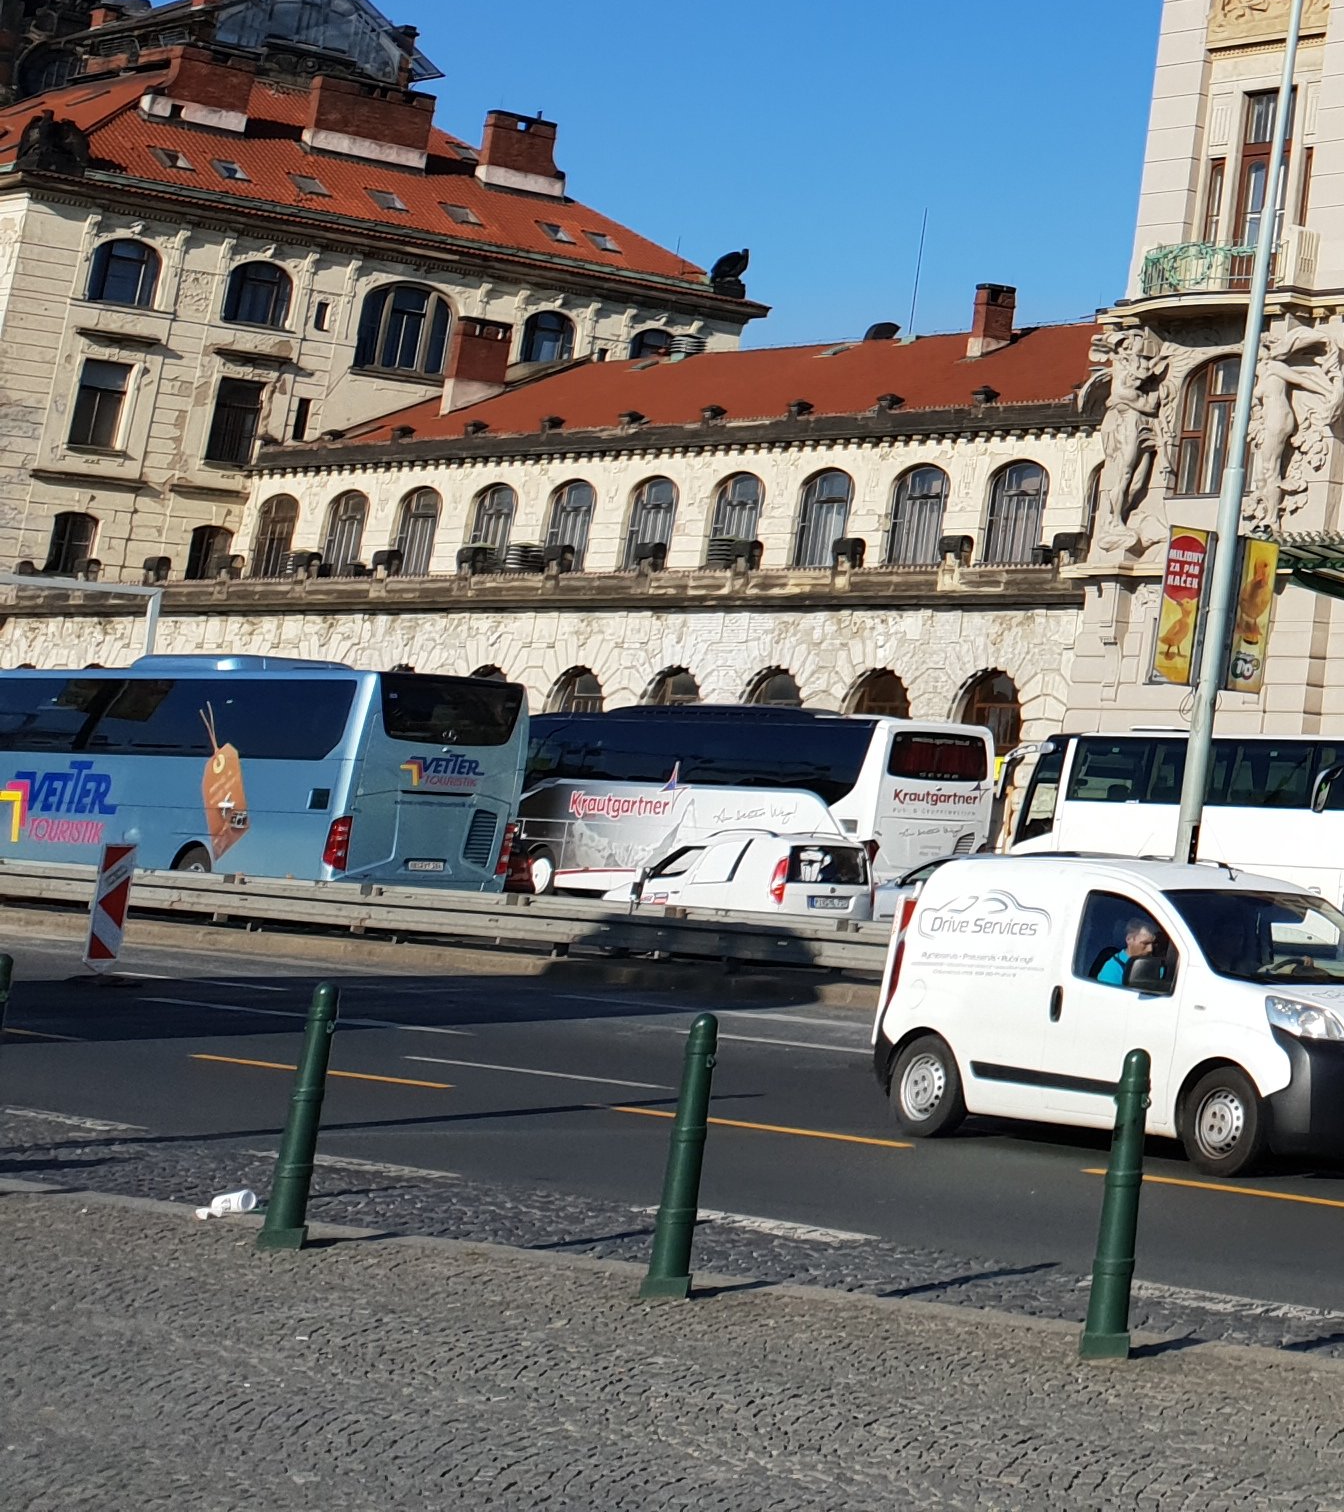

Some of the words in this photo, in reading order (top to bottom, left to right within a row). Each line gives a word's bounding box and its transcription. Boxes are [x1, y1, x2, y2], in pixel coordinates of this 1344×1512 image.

[1168, 549, 1204, 563] MILIONY
[1169, 562, 1181, 572] ZA
[1183, 563, 1200, 575] PÁR
[1166, 574, 1199, 589] KAČEK
[410, 753, 485, 777] VETTER
[15, 760, 119, 816] VETTER
[892, 787, 979, 807] Krautgartner
[569, 790, 670, 820] Krautgartner
[29, 817, 105, 844] TOURISTIK
[930, 916, 970, 934] Drive
[971, 917, 1040, 937] Services
